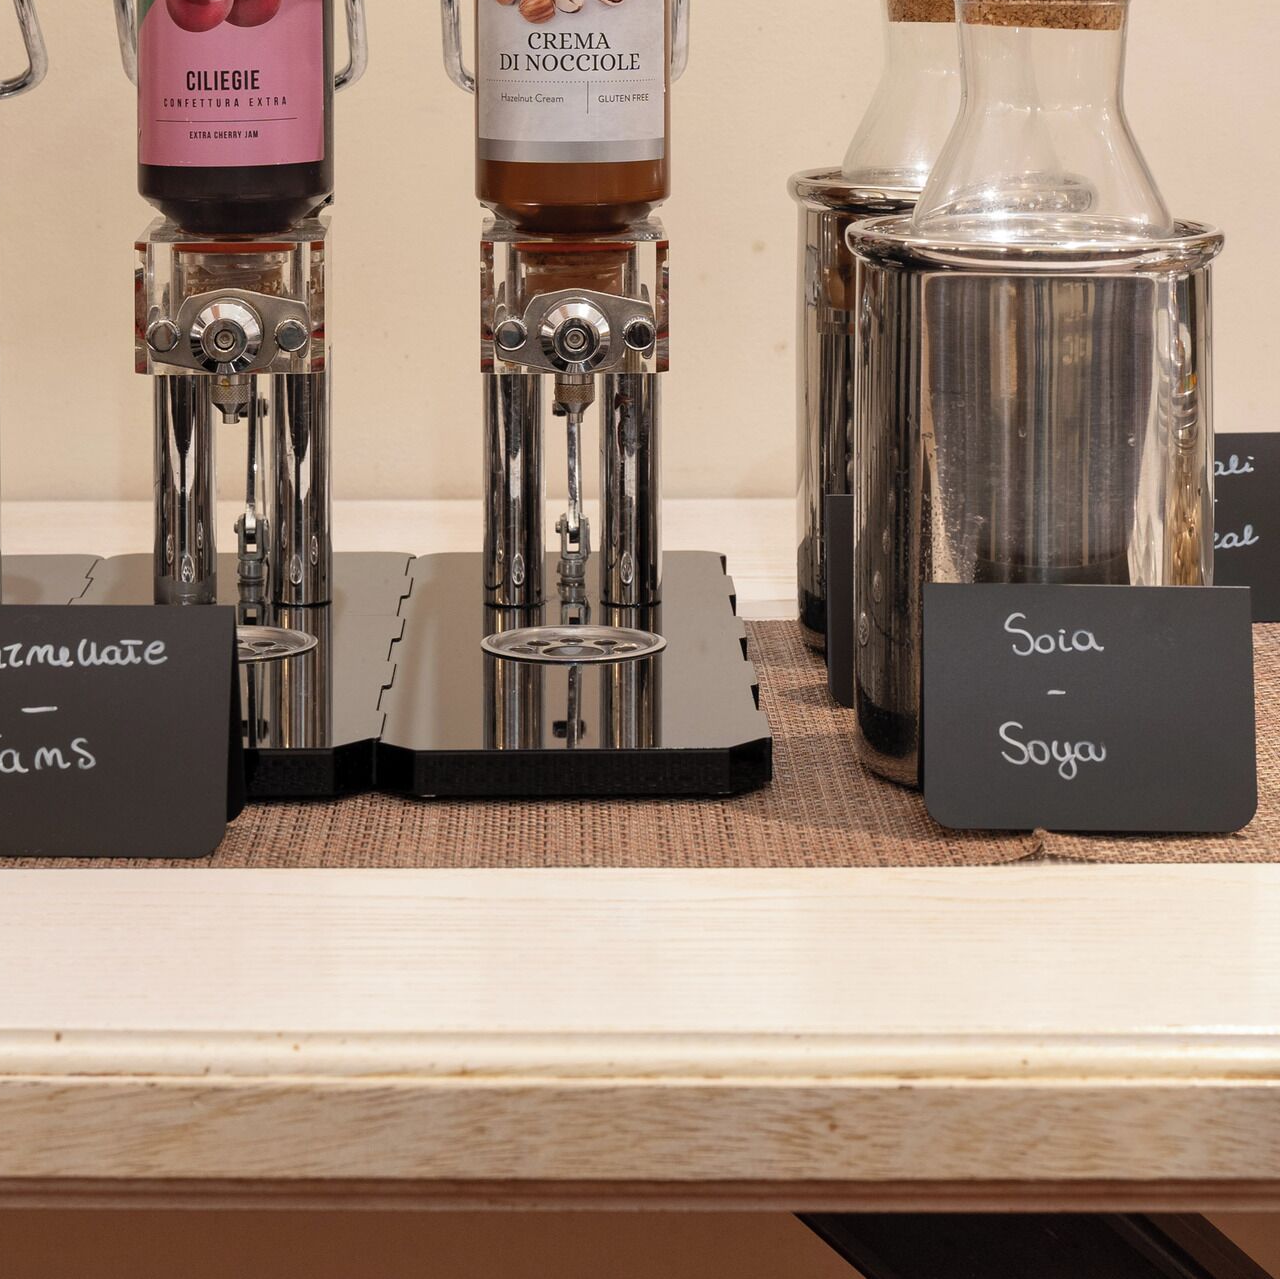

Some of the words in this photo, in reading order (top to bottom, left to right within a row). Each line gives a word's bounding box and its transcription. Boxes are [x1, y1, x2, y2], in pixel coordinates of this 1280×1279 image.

[527, 32, 611, 50] CREMA
[500, 53, 520, 71] DI
[525, 53, 641, 71] NOCCIOLE
[186, 70, 260, 91] CILIEGIE
[163, 98, 240, 108] CONFETTURA
[249, 96, 287, 107] EXTRA
[501, 93, 533, 103] Hazelnut
[535, 93, 564, 103] Cream
[598, 94, 631, 103] GLUTEN
[632, 93, 649, 102] FREE
[189, 131, 211, 139] EXTRA
[214, 131, 242, 139] CHERRY
[245, 130, 259, 138] JAM
[1004, 612, 1105, 656] Soia
[999, 721, 1107, 780] Soya
